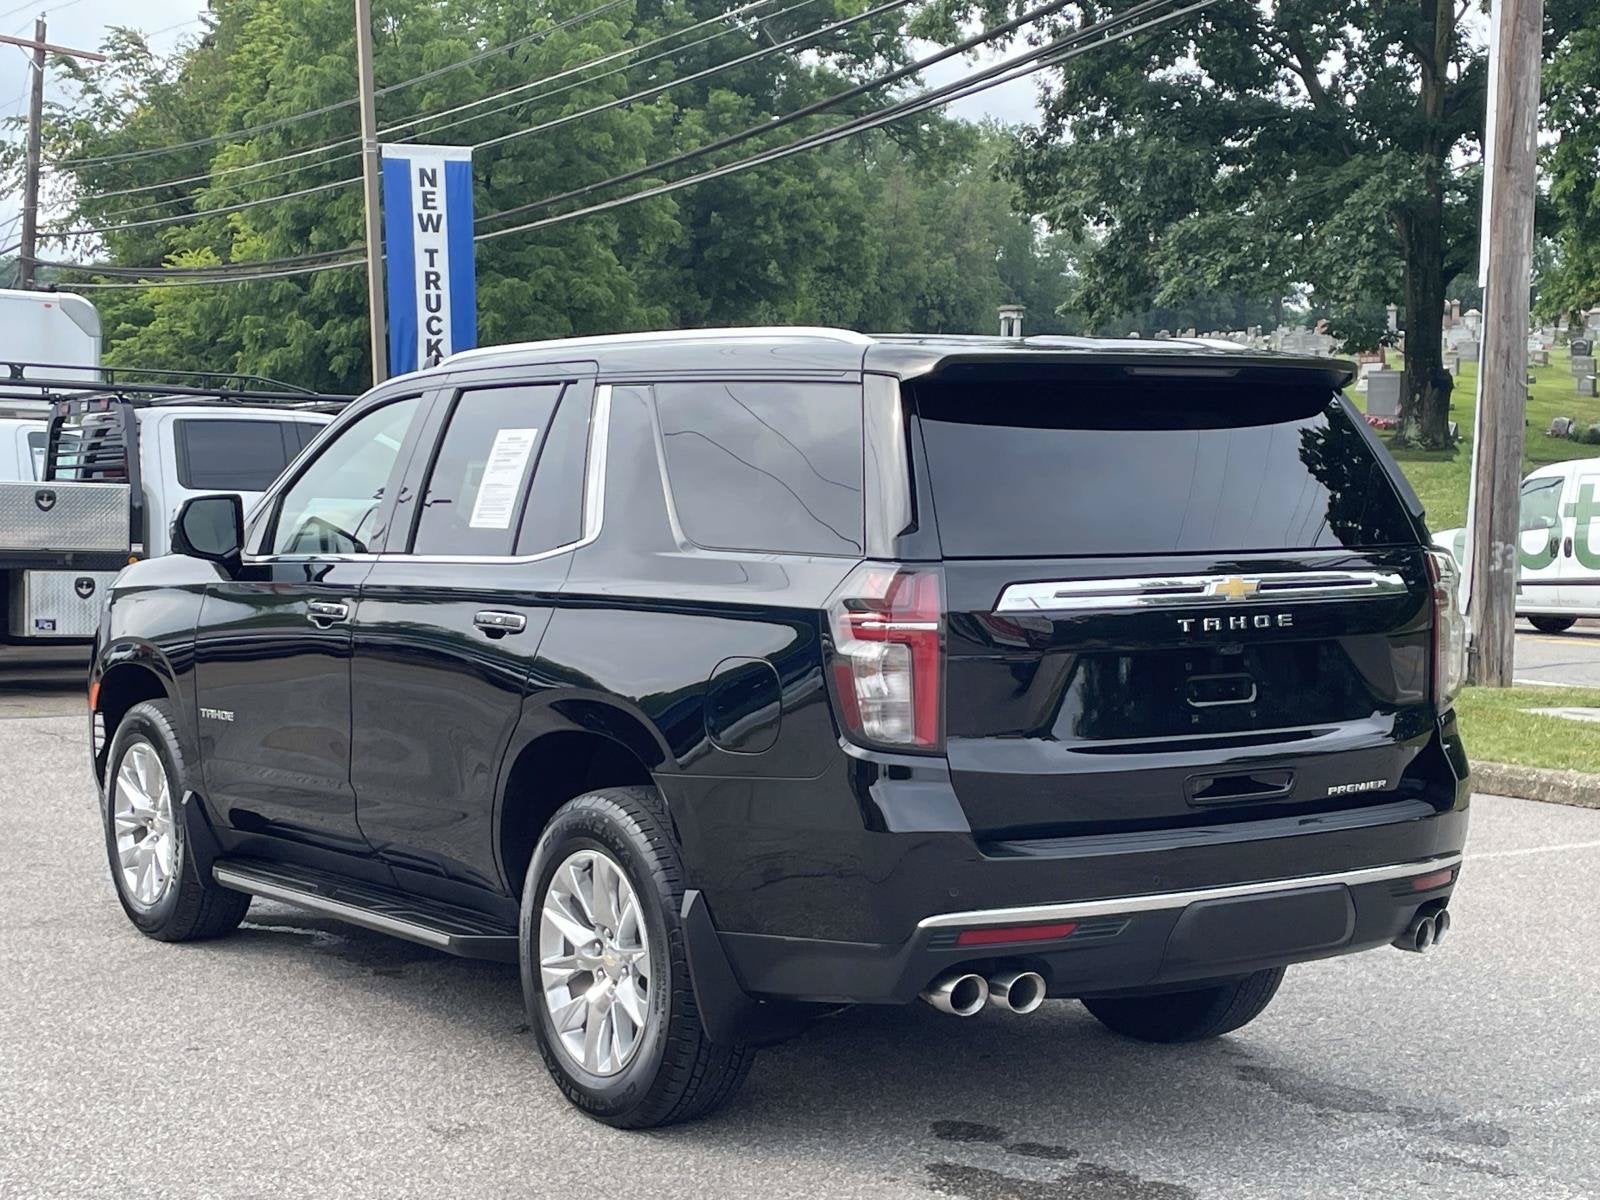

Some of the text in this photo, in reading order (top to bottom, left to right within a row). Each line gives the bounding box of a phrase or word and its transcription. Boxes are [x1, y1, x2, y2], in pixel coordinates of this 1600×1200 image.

[417, 167, 446, 367] NEW TRUCK
[1177, 613, 1294, 633] TAHOE
[199, 707, 235, 722] TAHOE
[1327, 779, 1387, 796] PREMIER
